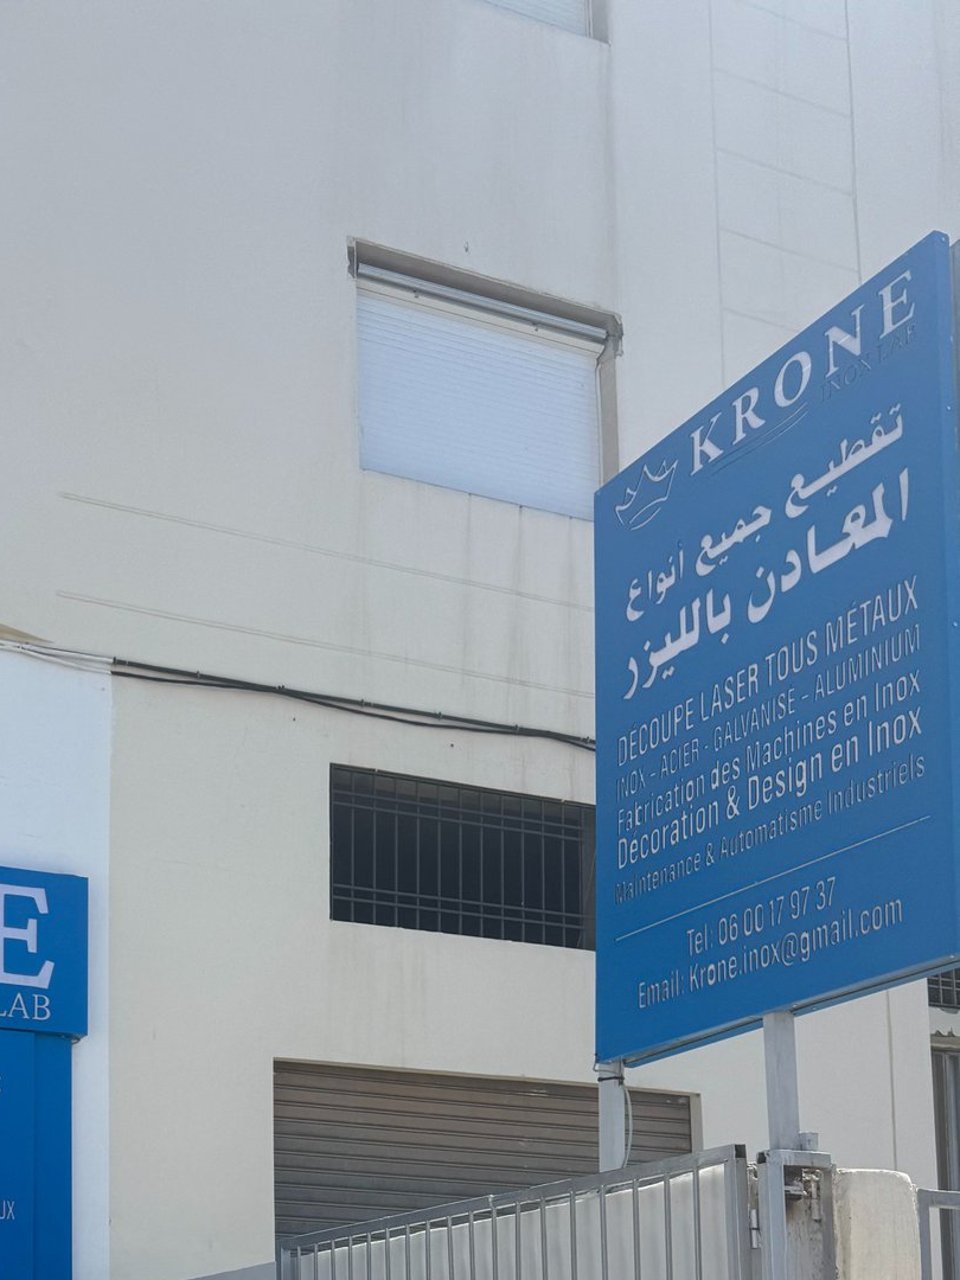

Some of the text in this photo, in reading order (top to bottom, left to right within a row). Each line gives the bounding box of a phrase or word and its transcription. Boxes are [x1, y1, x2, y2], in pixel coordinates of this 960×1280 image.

[689, 270, 915, 476] KRONE
[784, 403, 904, 519] تقطيع
[623, 467, 909, 700] المعادن بالليزر
[695, 505, 772, 577] جميع
[616, 768, 646, 803] INOX
[660, 737, 700, 780] ACIER
[814, 623, 920, 702] ALUMINIUM
[700, 663, 759, 721] LASER
[765, 629, 818, 686] TOUS
[618, 669, 920, 835] Fabrication des Machines en Inox
[618, 706, 922, 869] Décoration & Design en Inox
[615, 753, 925, 905] Maintenance & Automatisme Industriels
[637, 898, 903, 1009] Email: Krone.inox@gmail.com
[686, 876, 836, 957] Tel: 06 00 17 97 37
